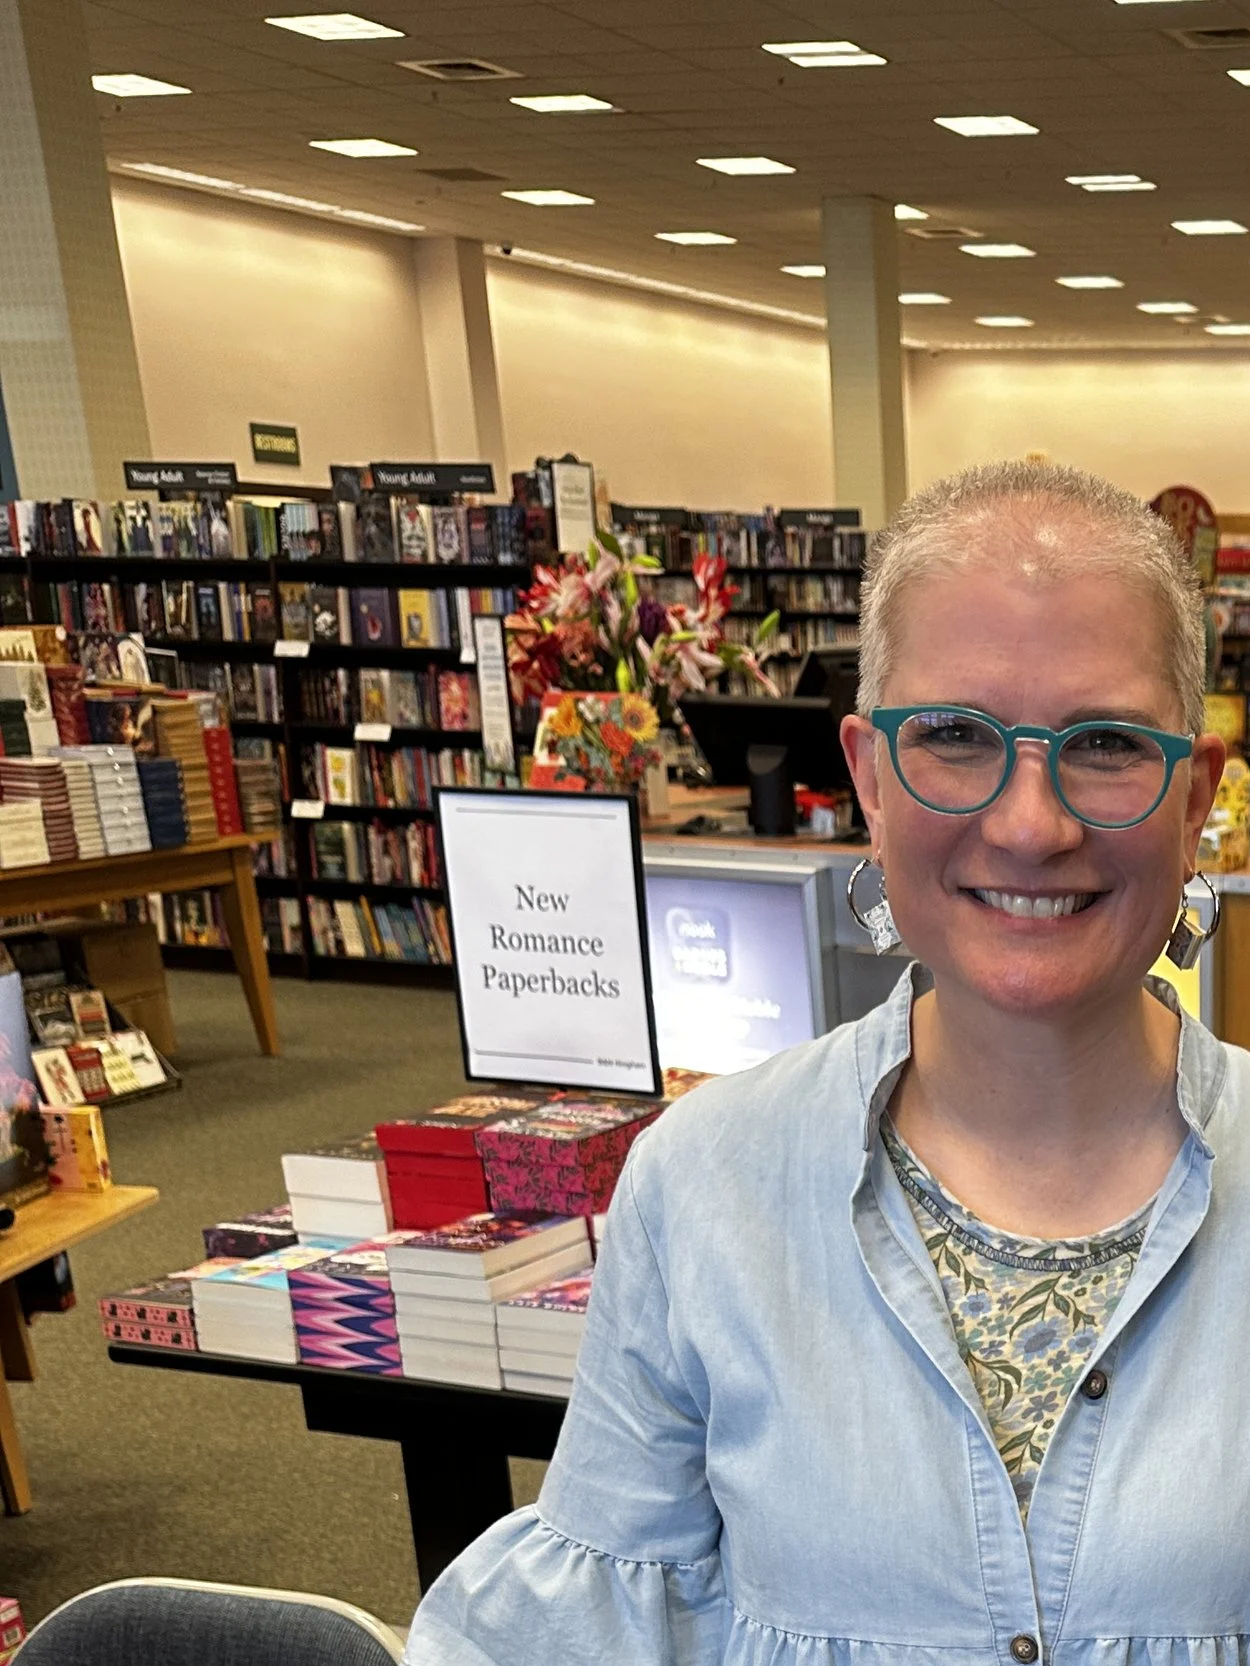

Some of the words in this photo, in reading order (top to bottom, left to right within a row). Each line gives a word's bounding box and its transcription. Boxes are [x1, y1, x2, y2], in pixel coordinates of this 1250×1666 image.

[131, 469, 159, 485] Young
[160, 470, 184, 483] Adult
[377, 471, 408, 487] Young
[409, 471, 436, 485] Adult
[514, 884, 569, 912] New
[489, 923, 604, 957] Romance
[481, 963, 621, 999] Paperbacks
